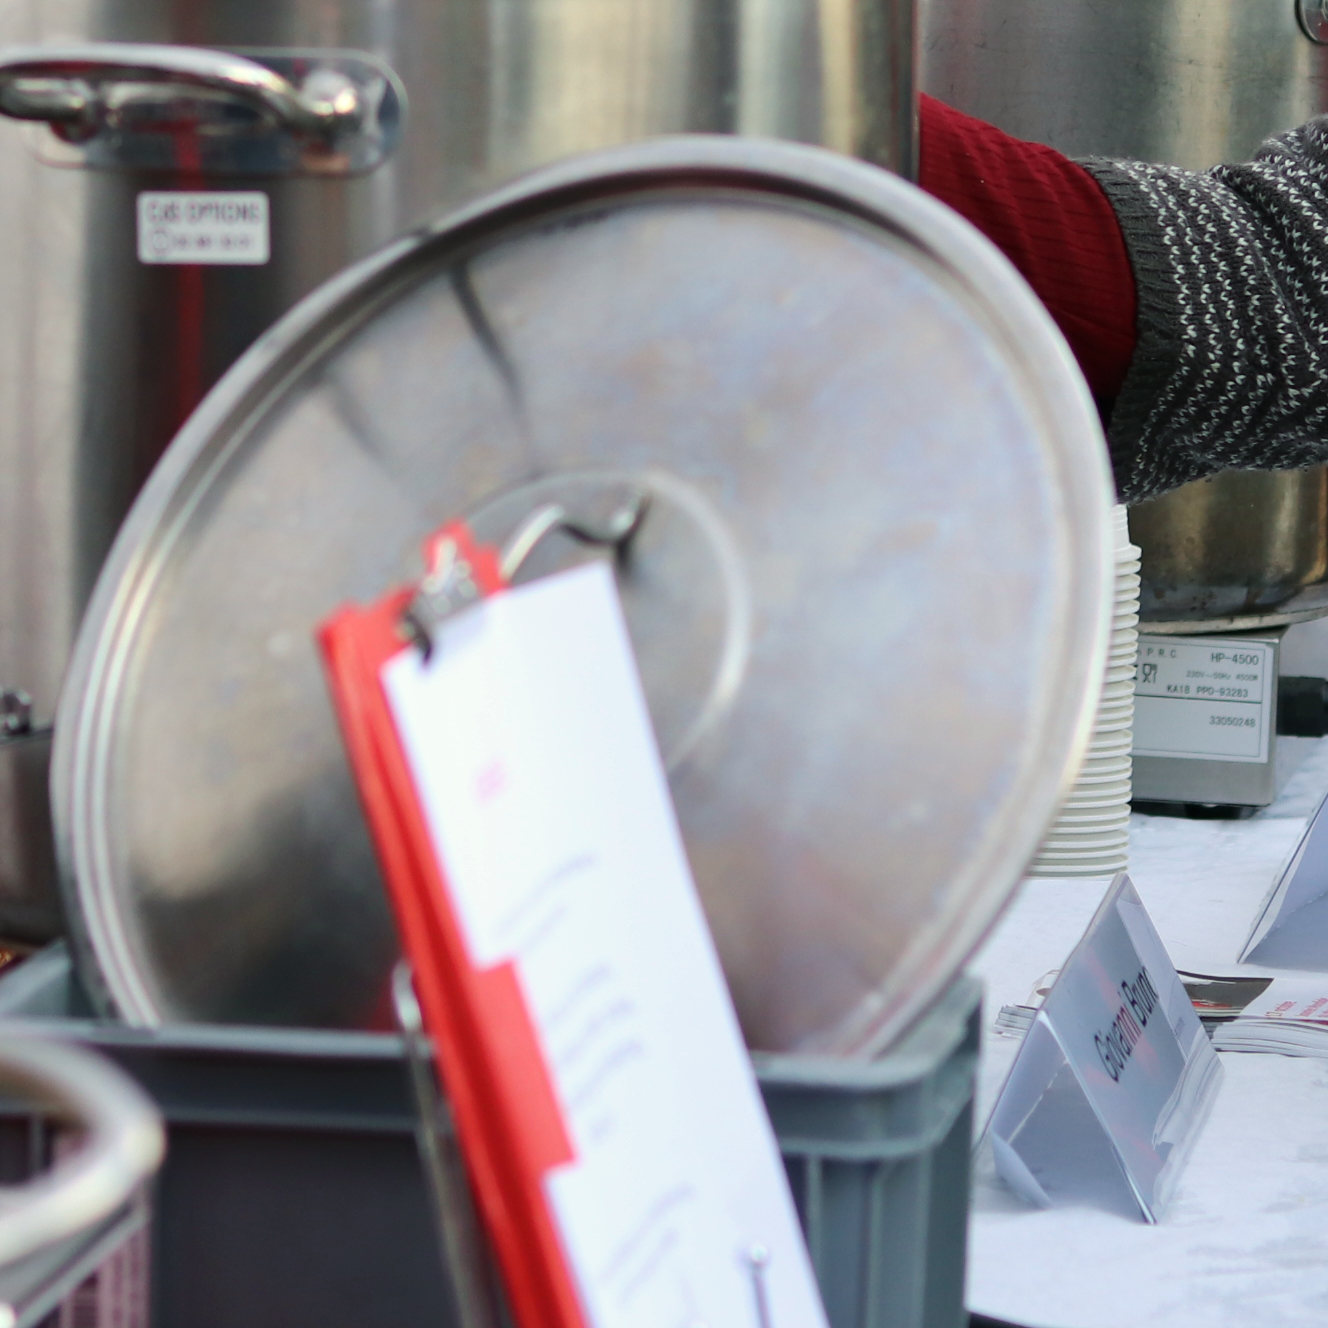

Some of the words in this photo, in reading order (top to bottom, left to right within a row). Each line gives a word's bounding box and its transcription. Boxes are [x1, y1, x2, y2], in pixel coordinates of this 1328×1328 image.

[1211, 652, 1260, 666] HP-4500
[1209, 715, 1256, 728] 33050248
[1094, 991, 1142, 1083] Giovanni
